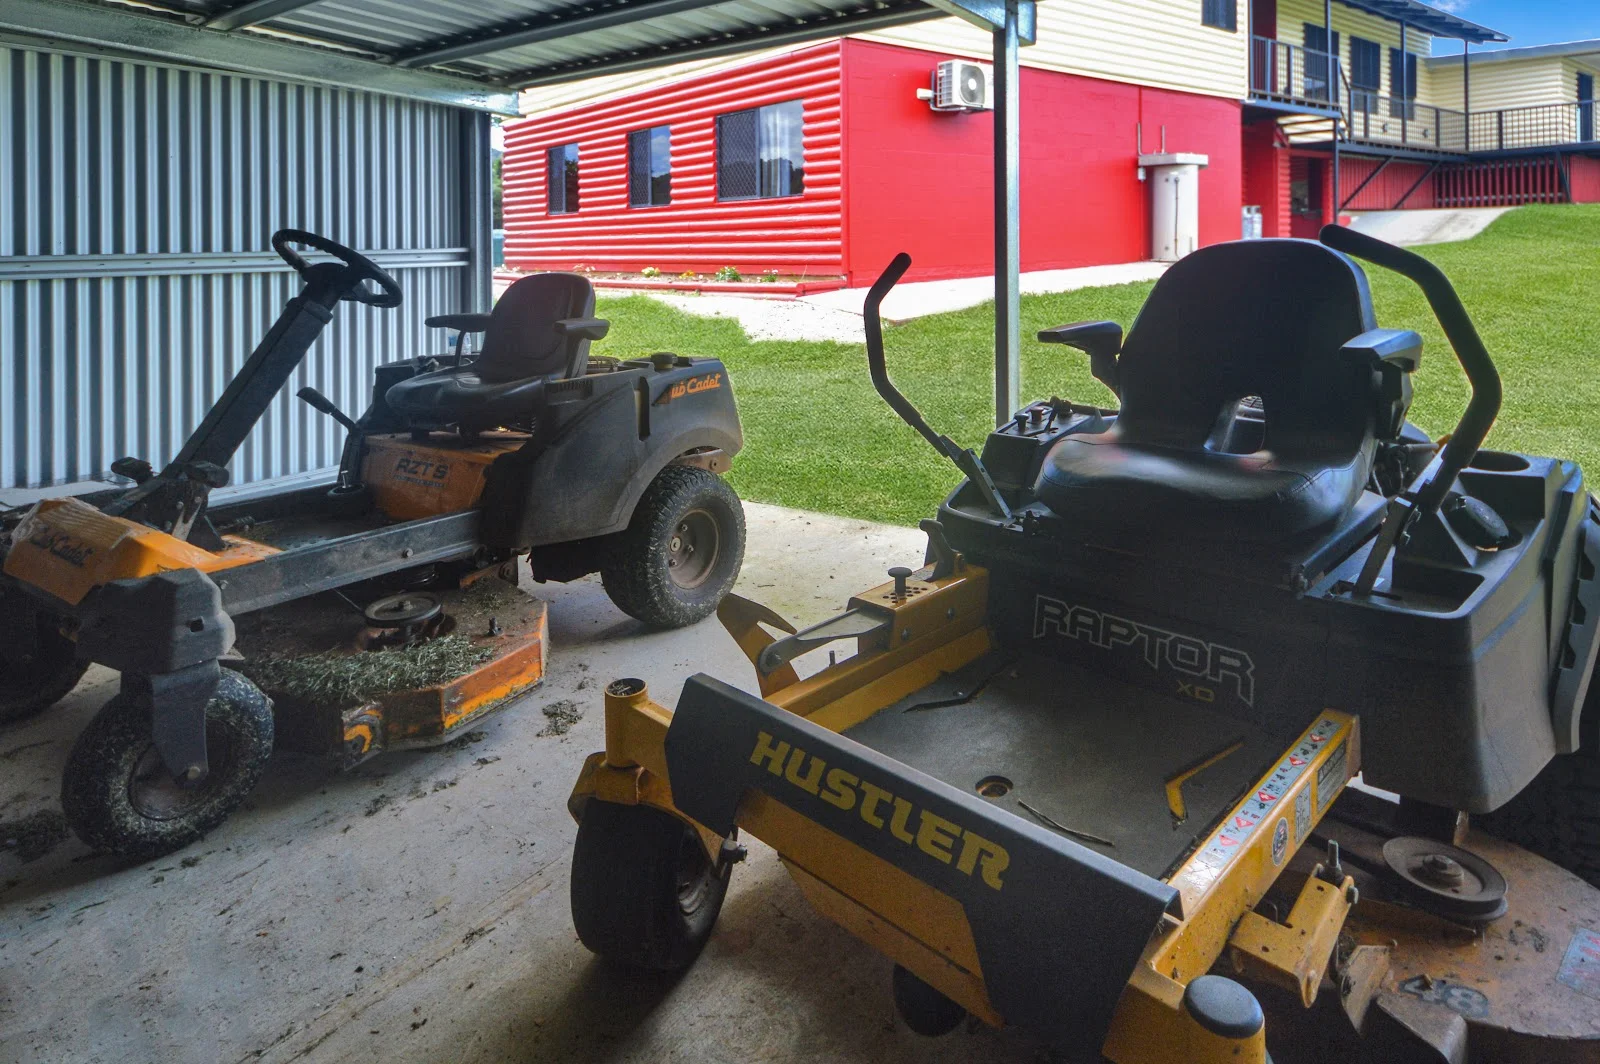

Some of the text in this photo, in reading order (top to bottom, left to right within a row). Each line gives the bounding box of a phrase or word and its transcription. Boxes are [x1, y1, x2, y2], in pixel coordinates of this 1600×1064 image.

[687, 373, 721, 393] Cadet
[396, 458, 434, 476] RZT
[1033, 594, 1255, 708] RAPTOR
[1176, 680, 1214, 702] XD
[750, 731, 1010, 891] HUSTLER
[1399, 975, 1489, 1018] 48
